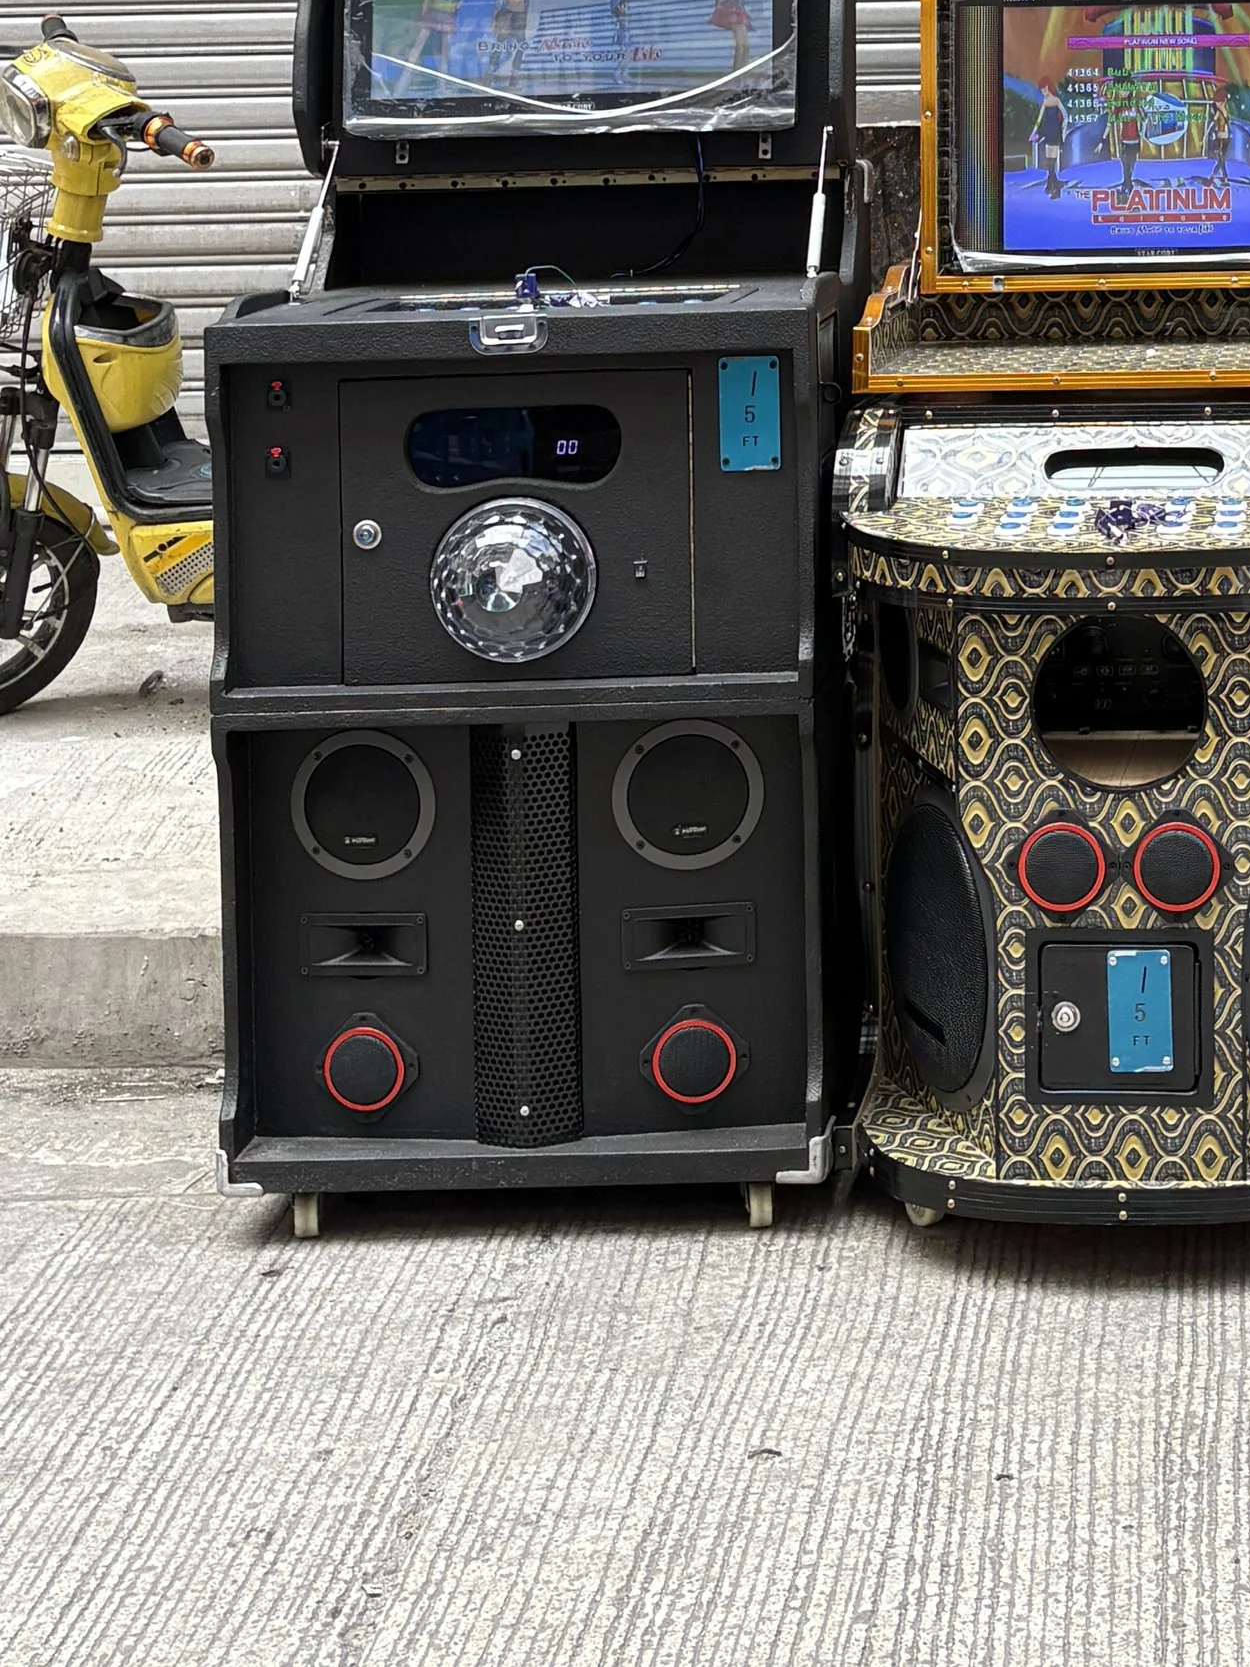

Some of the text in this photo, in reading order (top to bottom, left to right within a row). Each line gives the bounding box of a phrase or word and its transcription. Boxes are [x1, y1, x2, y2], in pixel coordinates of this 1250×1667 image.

[1075, 186, 1231, 212] THE PLATINUM
[744, 405, 756, 423] 5
[556, 439, 579, 455] 00
[742, 436, 759, 446] FT
[1133, 1003, 1147, 1022] 5
[1132, 1036, 1151, 1047] FT
